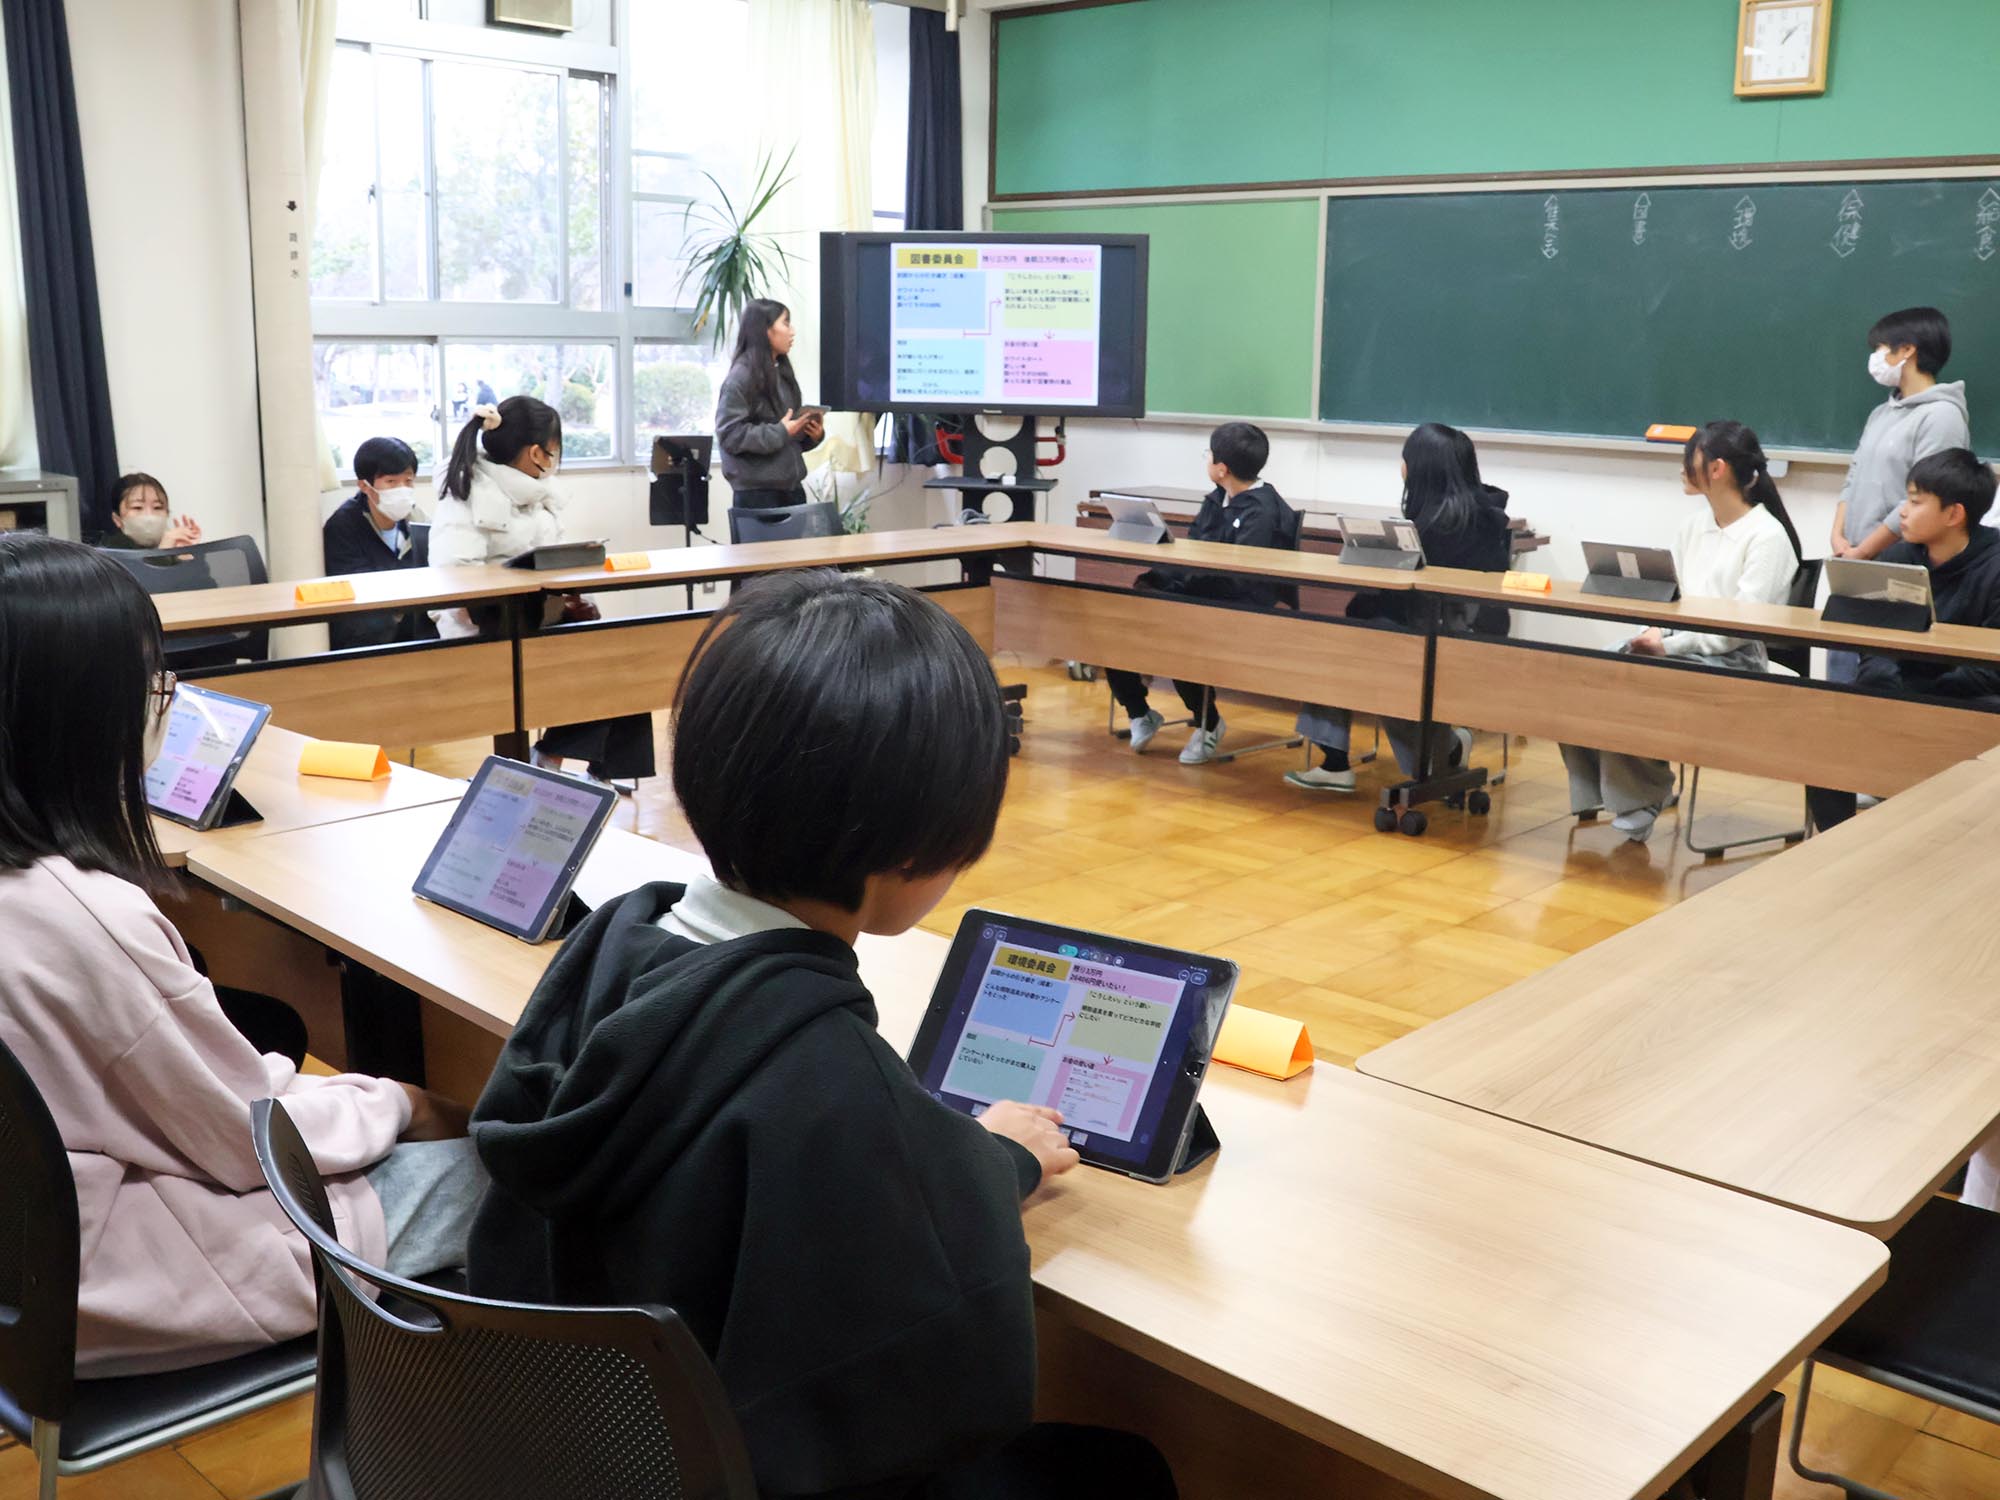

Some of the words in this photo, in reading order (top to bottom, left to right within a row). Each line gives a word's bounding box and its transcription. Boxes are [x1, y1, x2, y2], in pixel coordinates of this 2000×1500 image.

[910, 253, 964, 265] 図書委員会
[1008, 954, 1057, 974] 環境委員会
